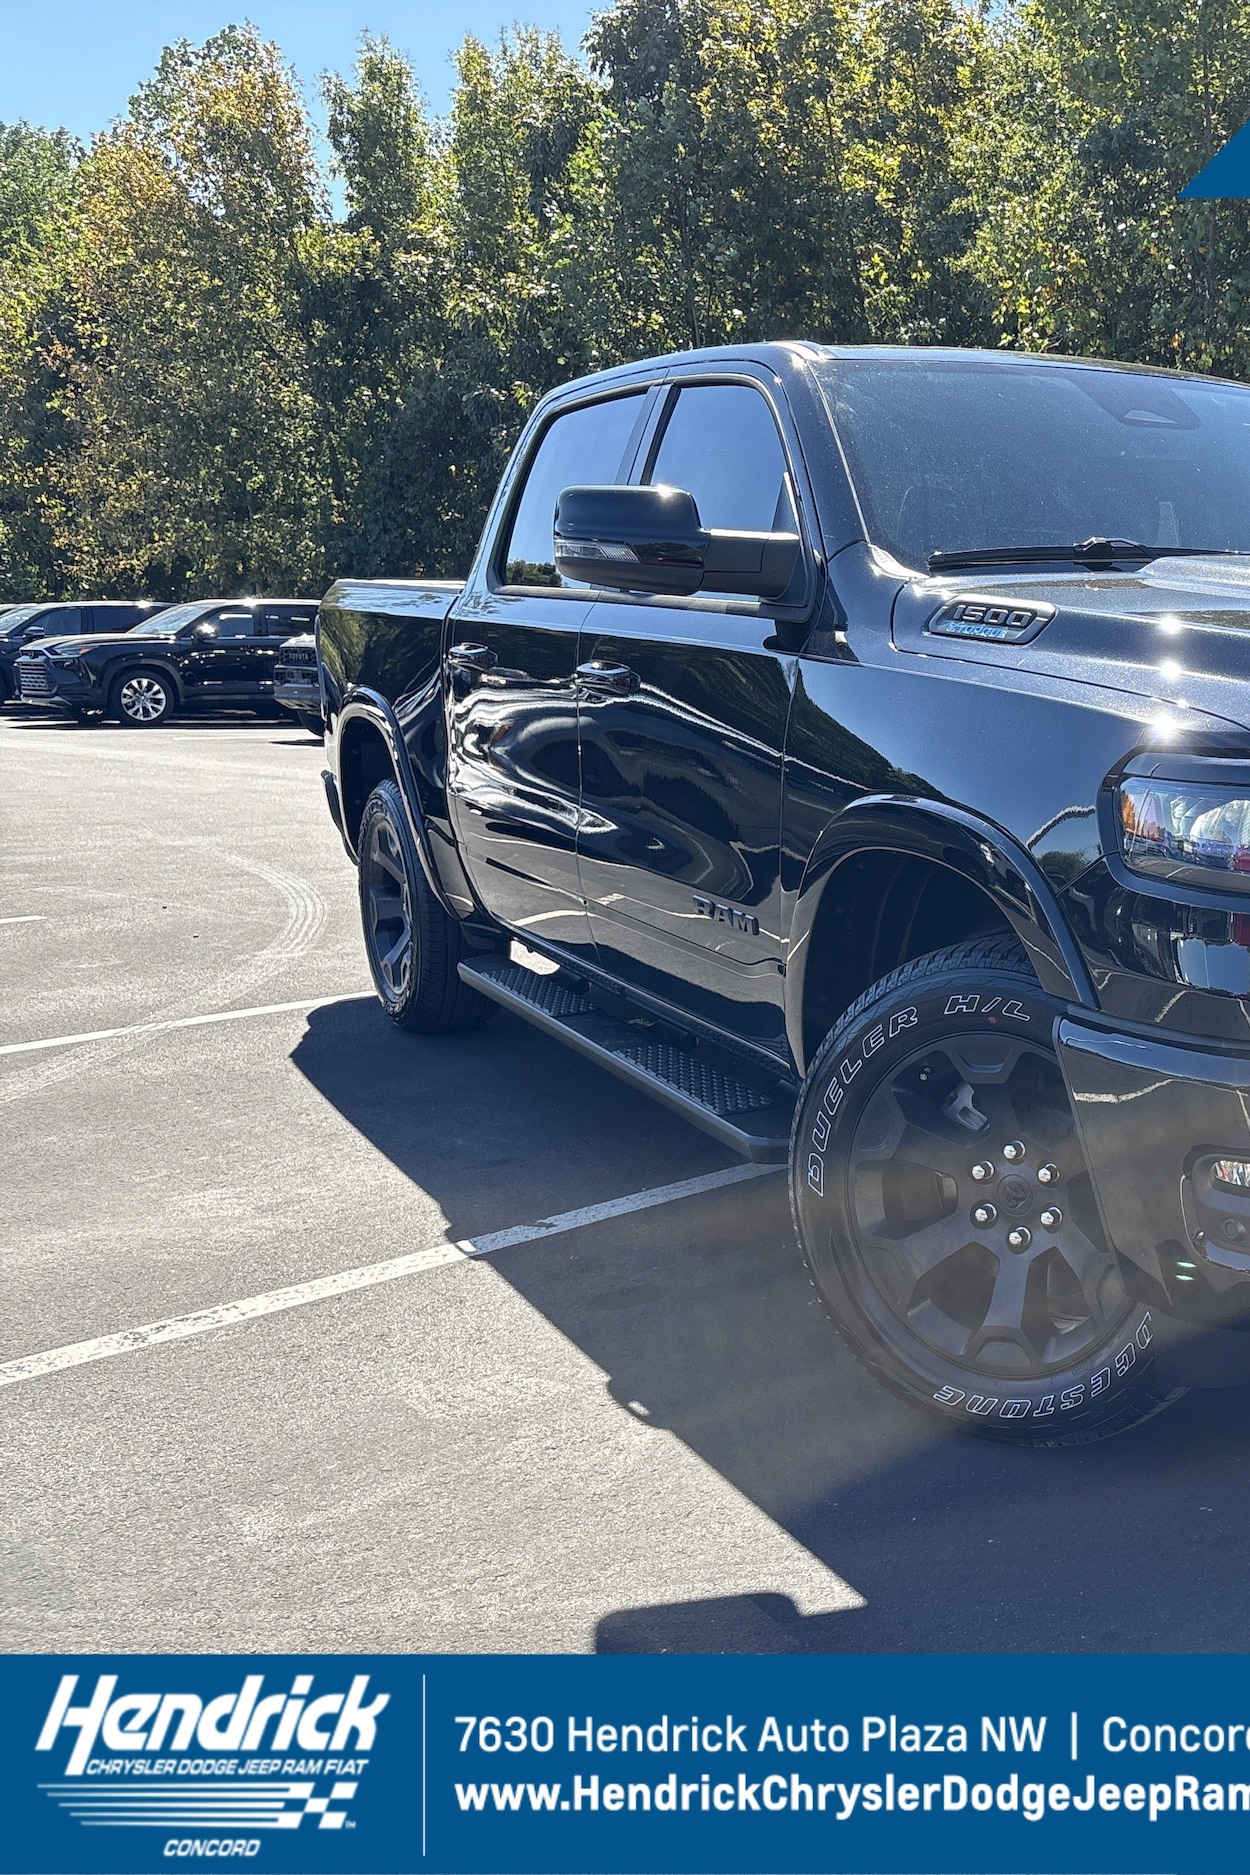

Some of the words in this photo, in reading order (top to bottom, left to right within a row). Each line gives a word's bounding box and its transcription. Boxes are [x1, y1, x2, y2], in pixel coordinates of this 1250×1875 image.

[953, 604, 1033, 627] 1500
[692, 894, 760, 936] RAM
[807, 1006, 918, 1198] DUELER
[943, 994, 1031, 1022] H/L
[932, 1311, 1154, 1419] DGESTONE
